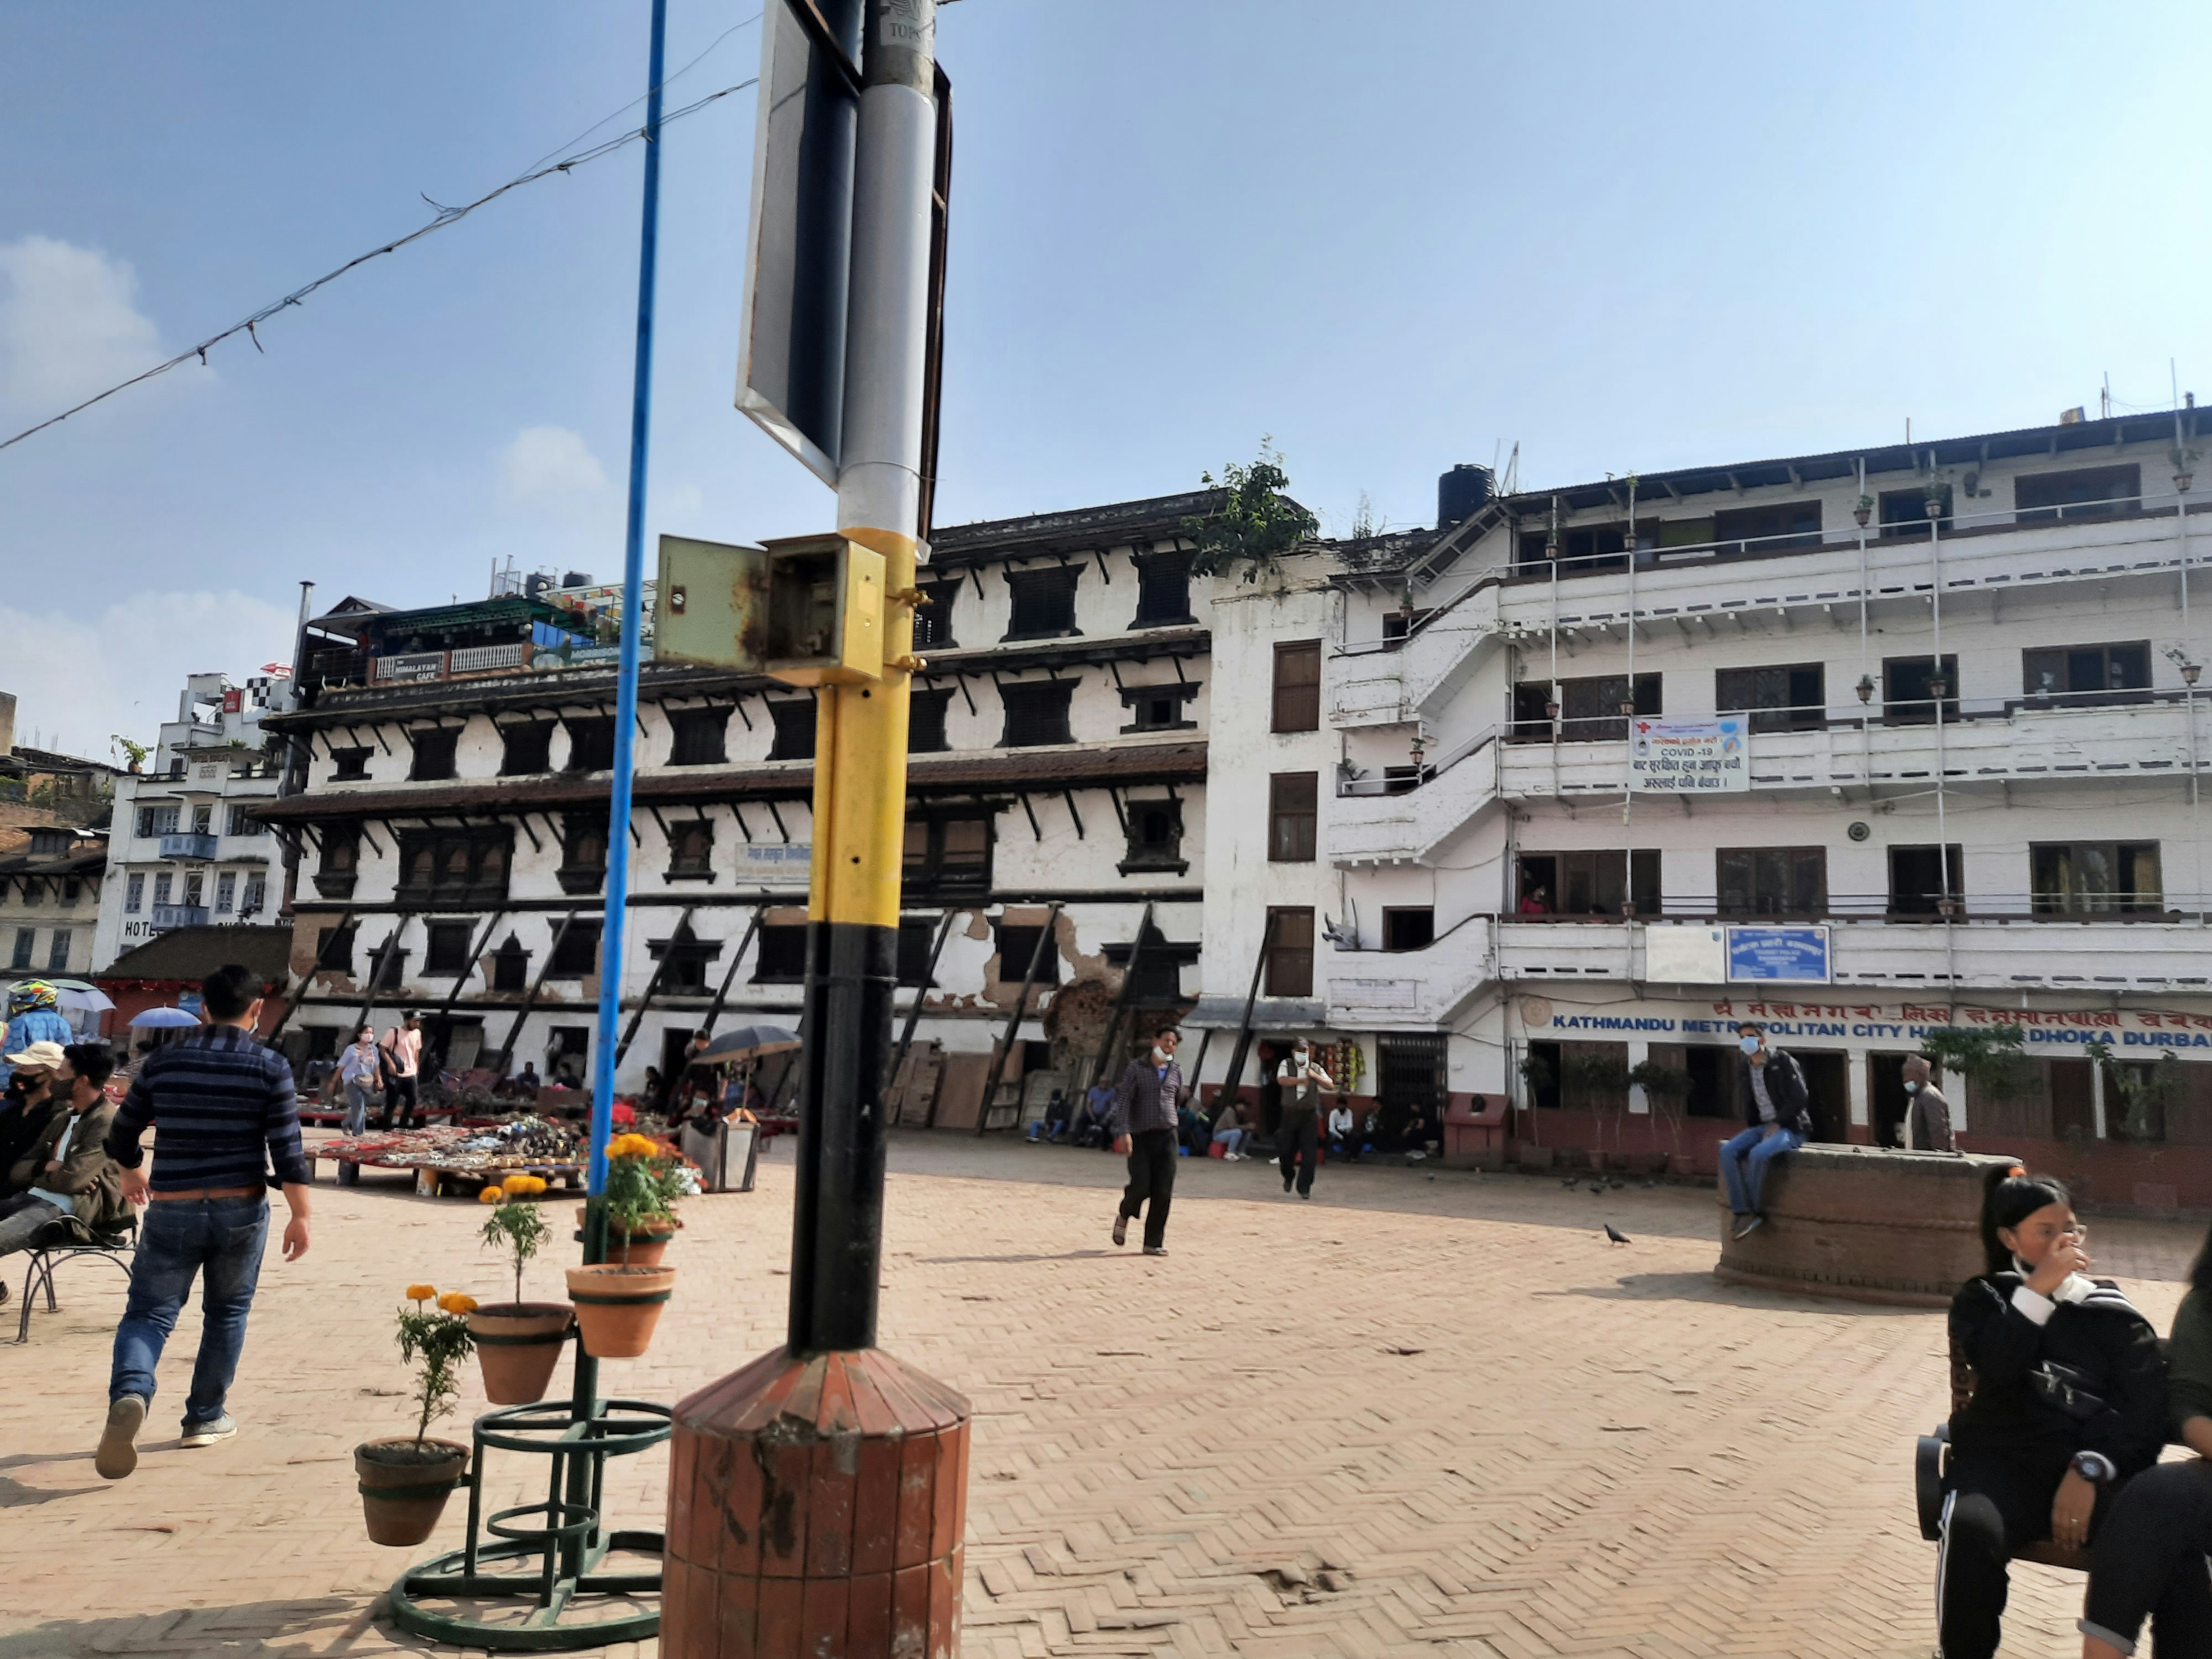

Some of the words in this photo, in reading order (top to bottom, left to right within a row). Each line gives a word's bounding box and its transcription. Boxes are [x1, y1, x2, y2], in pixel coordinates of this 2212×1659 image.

[1661, 748, 1695, 757] COVID
[1553, 1015, 1675, 1031] KATHMANDU
[1682, 1019, 1846, 1036] METRPOLITAN
[1853, 1024, 1903, 1038] CITY
[2030, 1029, 2116, 1045] DHOKA
[2123, 1031, 2212, 1047] DURBA
